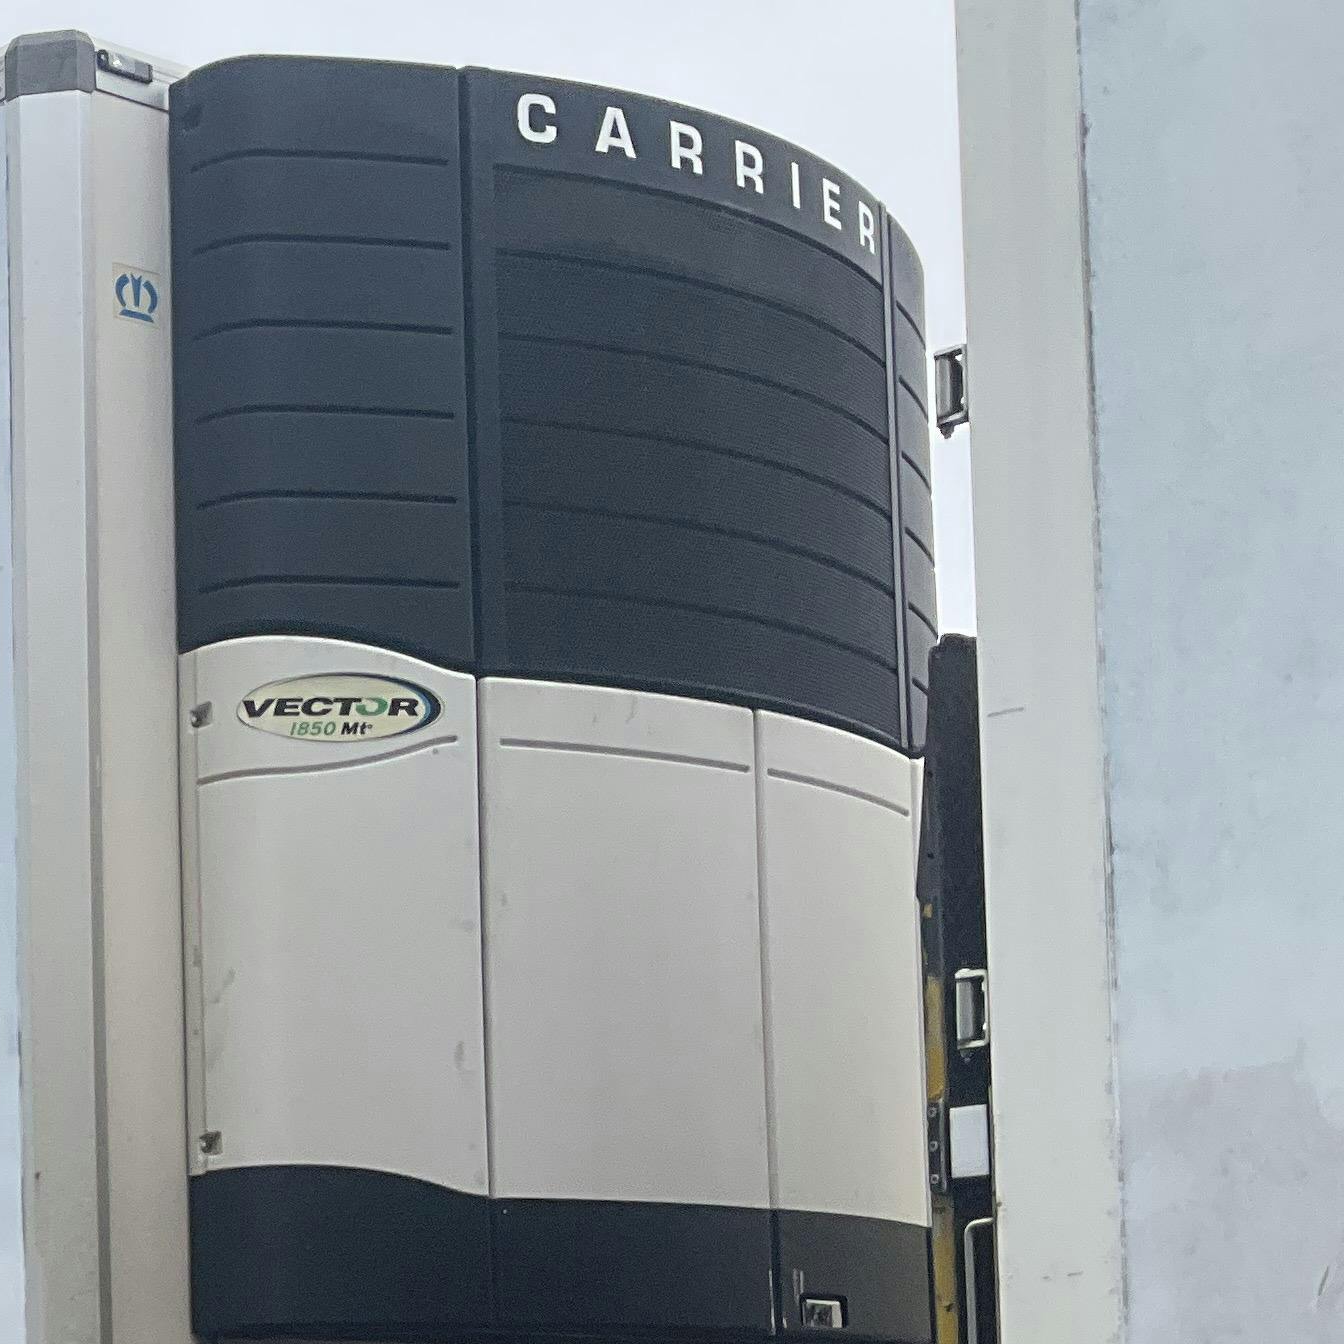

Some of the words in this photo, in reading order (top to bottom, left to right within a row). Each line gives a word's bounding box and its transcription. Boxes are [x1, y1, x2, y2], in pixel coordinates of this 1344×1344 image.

[516, 92, 877, 255] CARRIER
[242, 696, 419, 719] VECTOR
[289, 720, 337, 736] 1850
